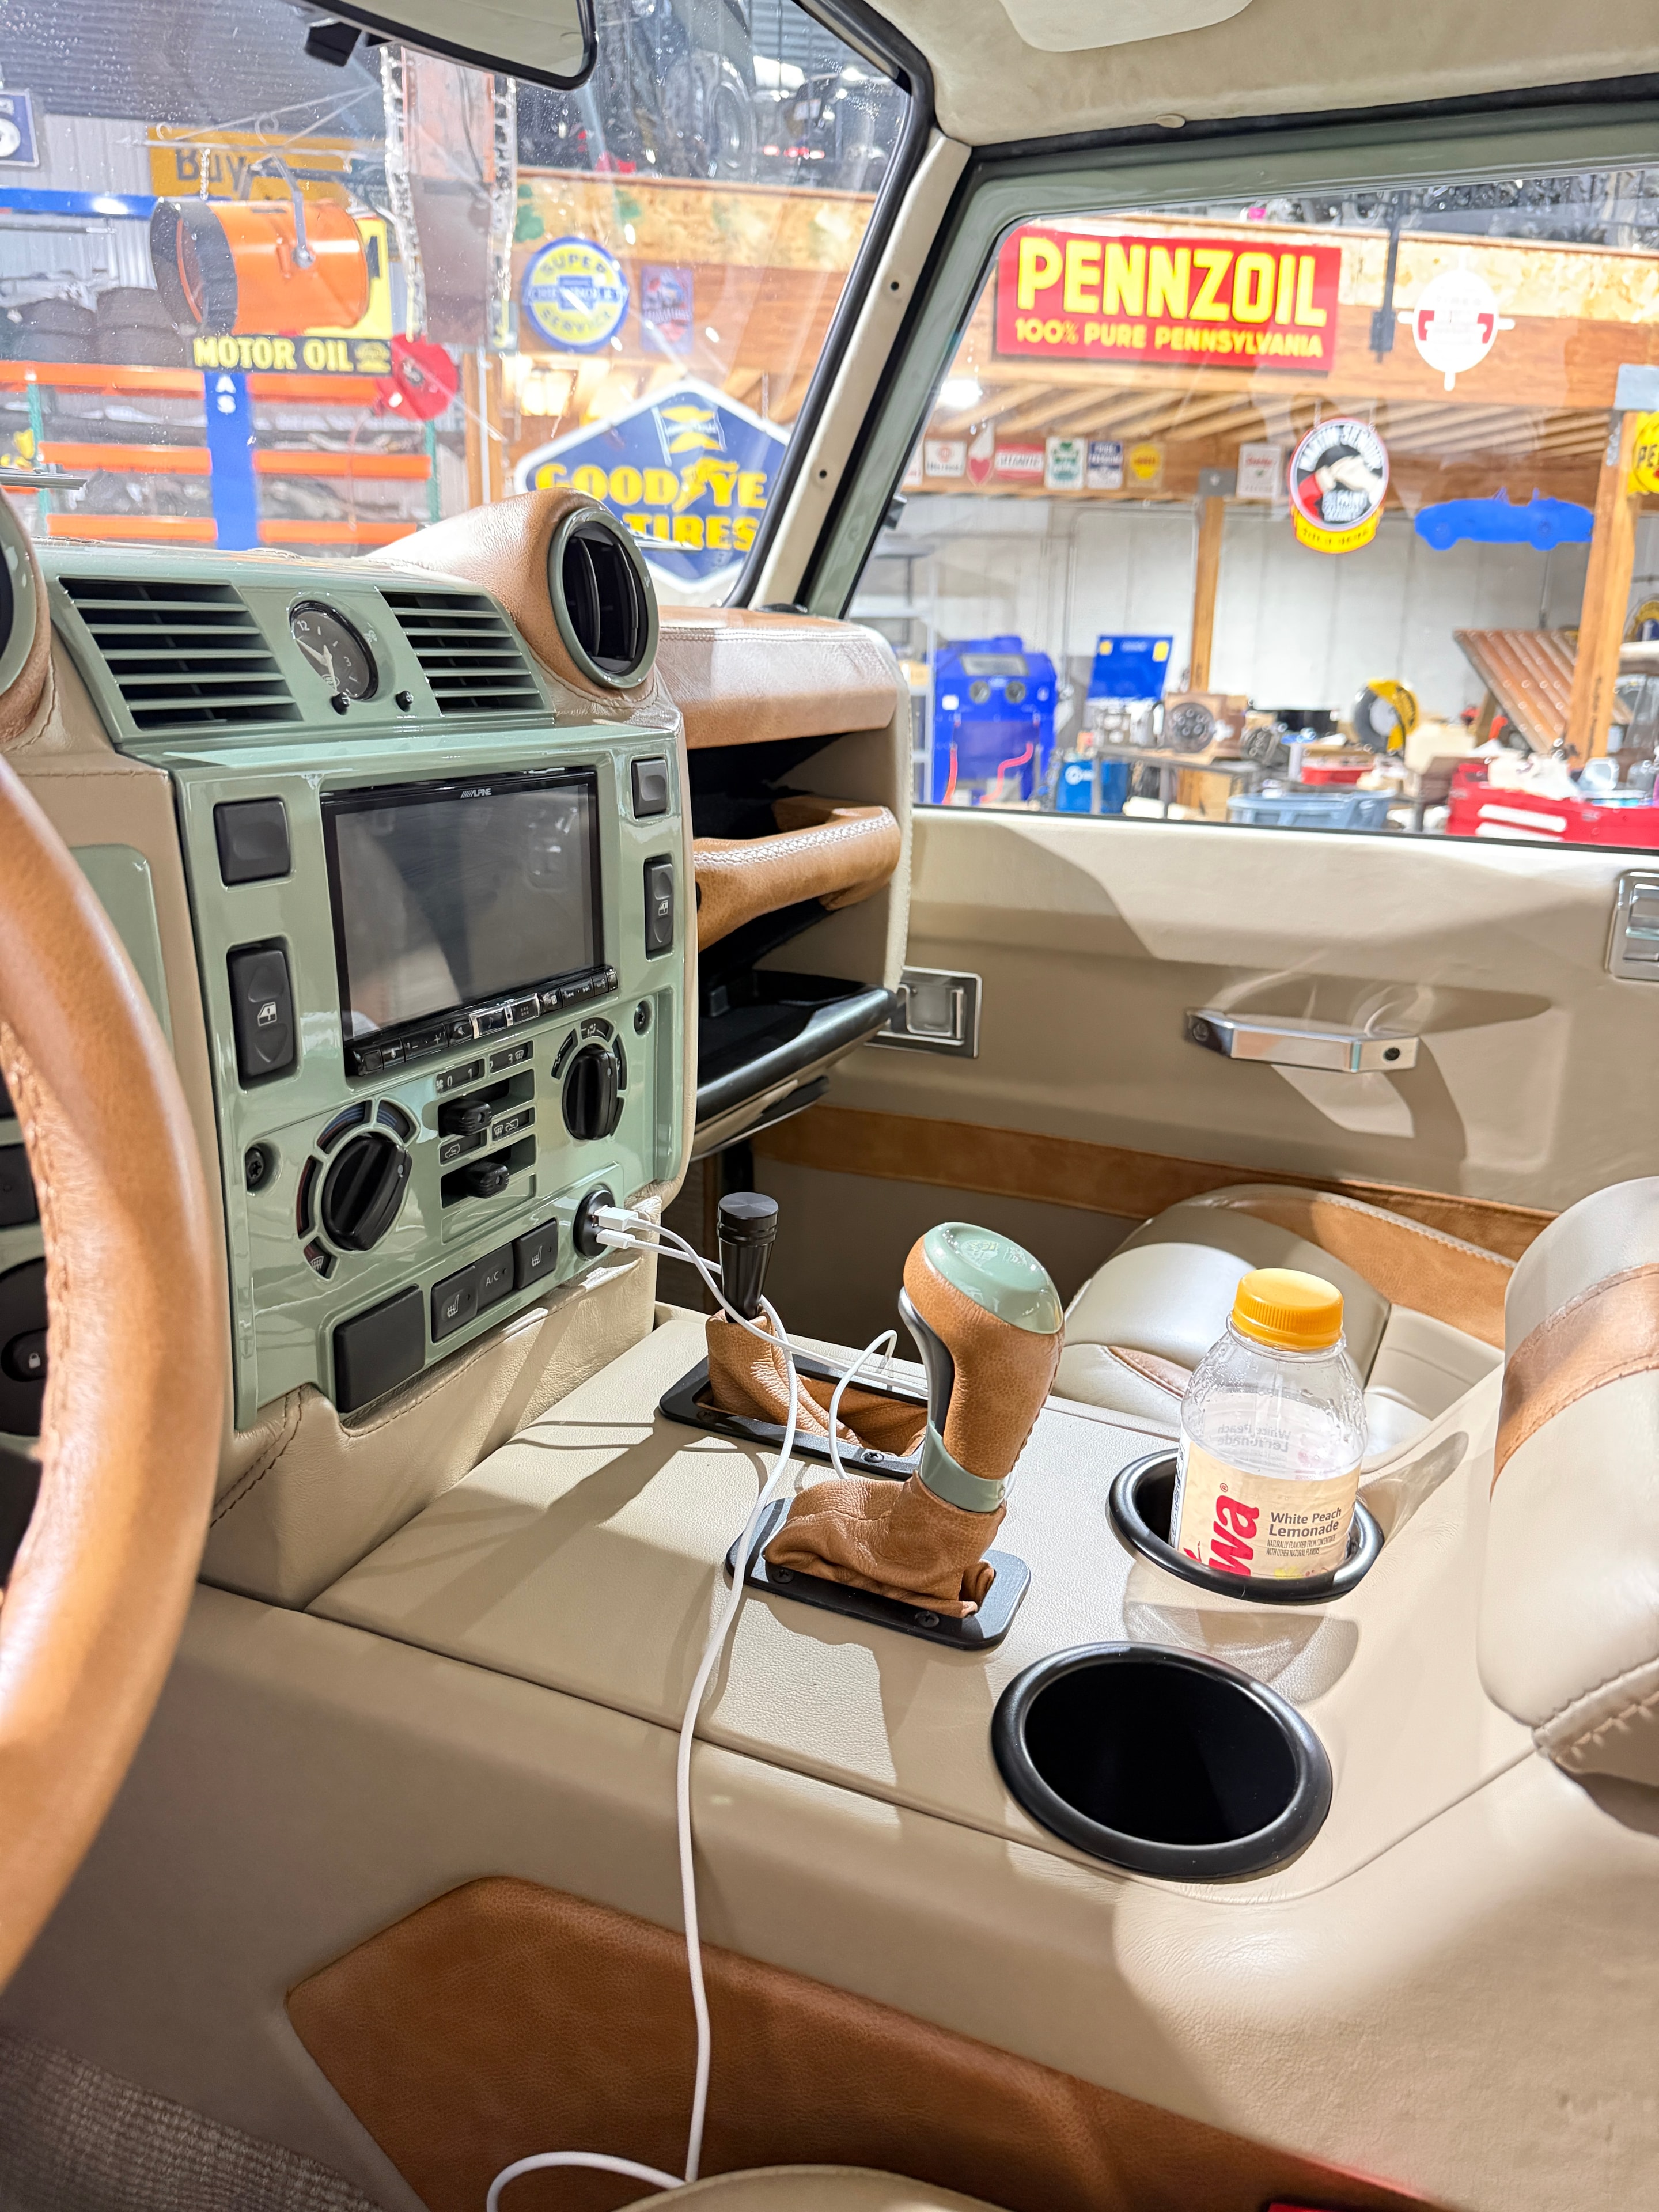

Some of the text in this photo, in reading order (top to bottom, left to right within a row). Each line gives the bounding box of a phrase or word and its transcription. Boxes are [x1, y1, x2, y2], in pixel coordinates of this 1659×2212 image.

[1017, 236, 1327, 327] PENNZOIL
[1015, 317, 1324, 358] 100% PURE PENNSYLVANIA
[193, 335, 354, 372] MOTOR OIL
[535, 463, 767, 509] GOODYE
[623, 513, 760, 551] TIRES
[297, 620, 310, 631] 12
[486, 1271, 499, 1287] A/C
[1269, 1520, 1339, 1537] Lemonade
[1271, 1507, 1342, 1525] White Peach
[1209, 1495, 1260, 1577] wa
[1267, 1539, 1288, 1549] NATURALLY
[1289, 1540, 1306, 1549] FLAVORED
[1307, 1539, 1316, 1548] FROM
[1266, 1547, 1320, 1557] WITH OTHER NATURAL FLAVORS
